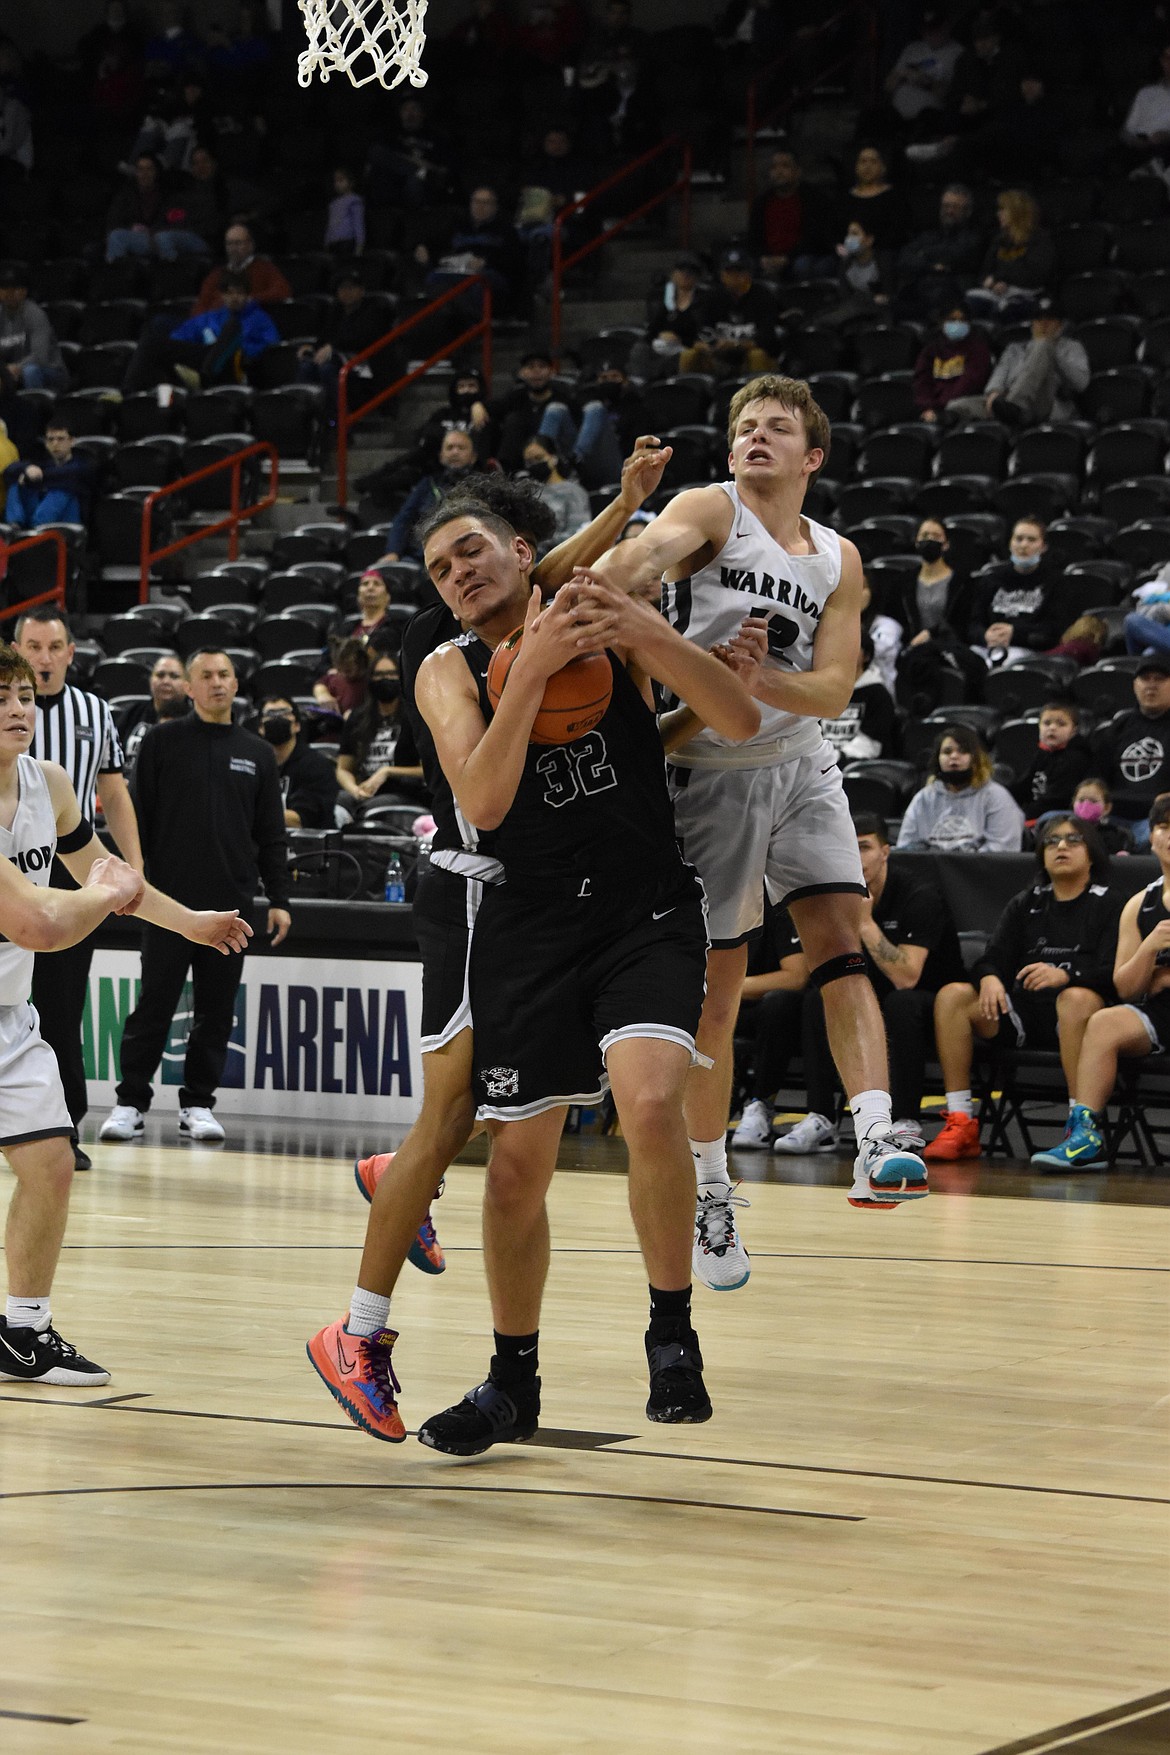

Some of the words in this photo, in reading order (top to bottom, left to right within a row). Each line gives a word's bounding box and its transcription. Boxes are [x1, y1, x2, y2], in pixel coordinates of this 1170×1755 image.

[720, 566, 822, 621] WARRIO
[536, 730, 618, 808] 32
[253, 983, 412, 1098] ARENA
